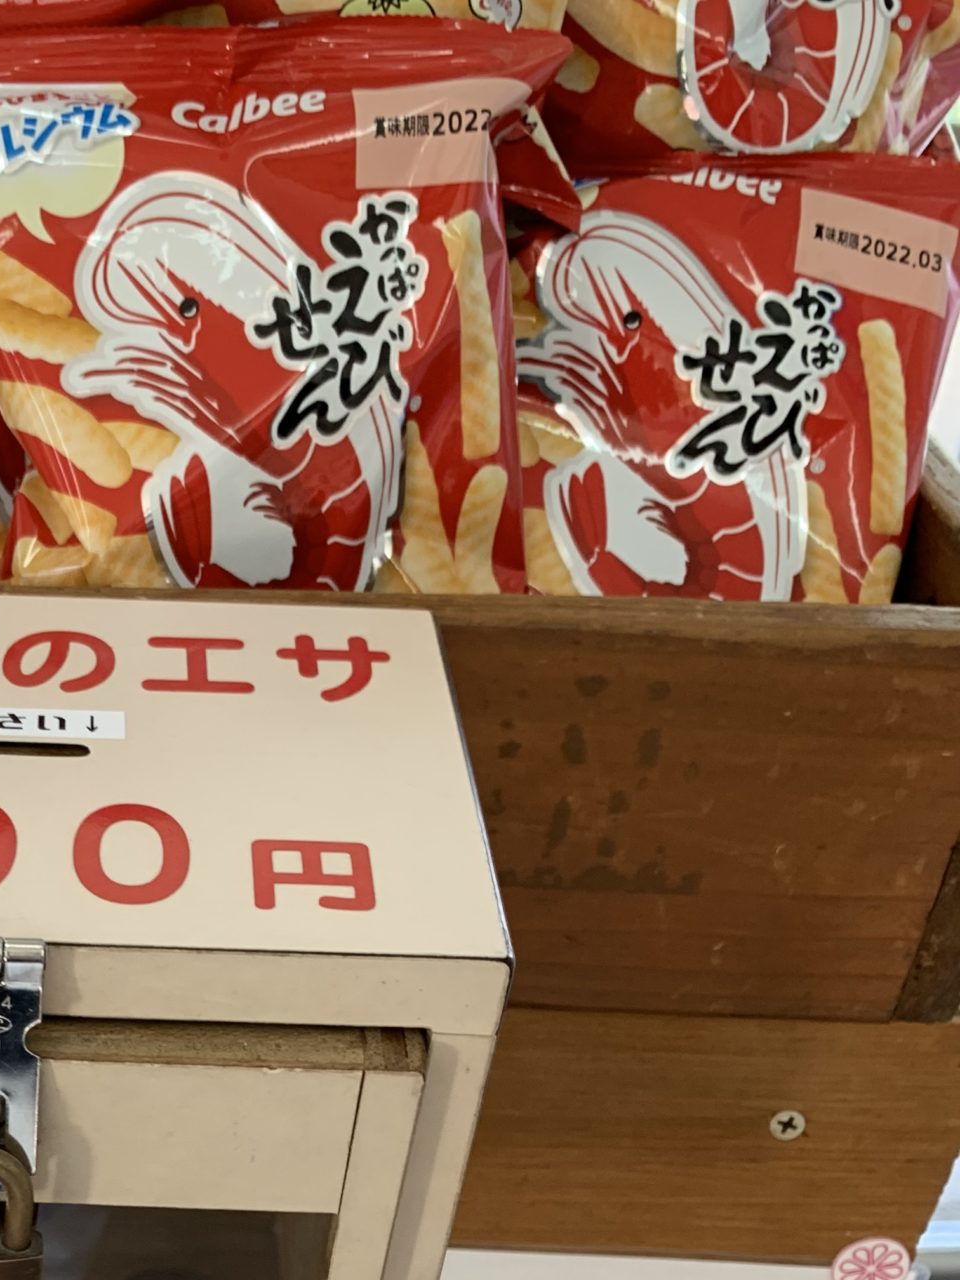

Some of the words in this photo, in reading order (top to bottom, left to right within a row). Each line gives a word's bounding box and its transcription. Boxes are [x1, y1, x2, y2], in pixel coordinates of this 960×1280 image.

[170, 89, 327, 134] Calbee
[252, 263, 351, 441] せん
[676, 318, 758, 476] せん
